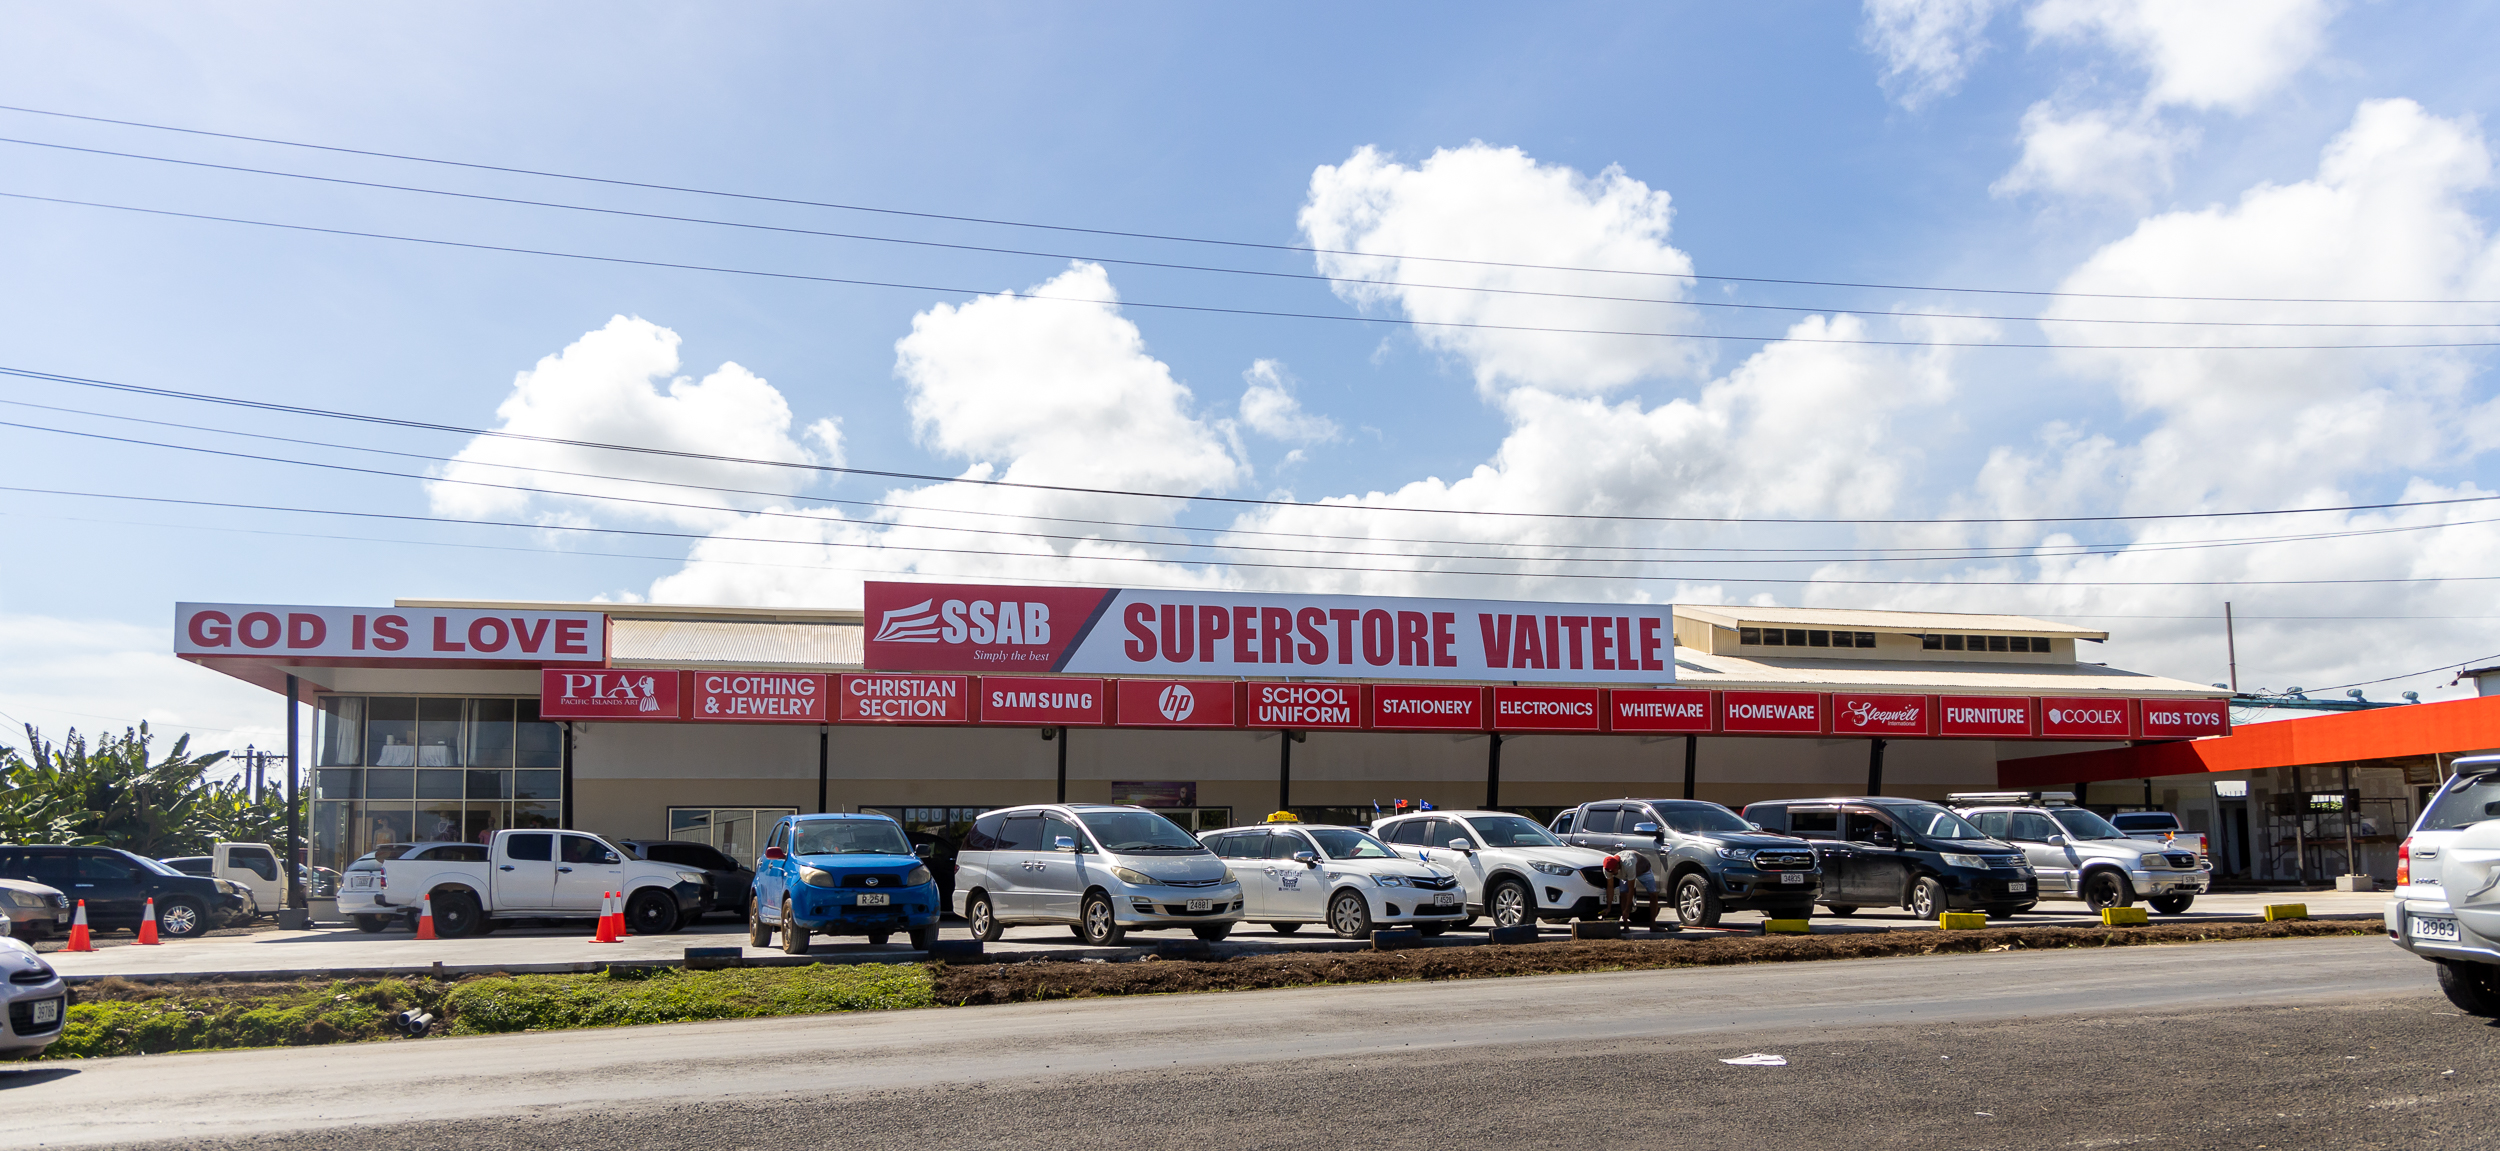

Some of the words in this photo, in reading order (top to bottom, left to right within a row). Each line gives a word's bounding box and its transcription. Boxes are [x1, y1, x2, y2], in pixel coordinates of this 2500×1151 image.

[942, 600, 1050, 644] SSAB
[189, 611, 326, 648] GOD
[352, 615, 409, 651] IS
[433, 617, 588, 654] LOVE
[1124, 603, 1457, 667] SUPERSTORE
[1478, 614, 1663, 670] VAITELE
[974, 650, 1008, 662] Simply
[1011, 650, 1026, 660] the
[1029, 651, 1050, 661] best
[561, 674, 639, 698] PIA
[706, 677, 815, 695] CLOTHING
[850, 679, 955, 697] CHRISTIAN
[993, 692, 1091, 709] SAMSUNG
[1161, 685, 1193, 721] hp
[1262, 687, 1347, 704] SCHOOL
[705, 697, 719, 713] &
[726, 697, 815, 715] JEWELRY
[860, 699, 945, 716] SECTION
[1259, 706, 1349, 722] UNIFORM
[1383, 700, 1472, 714] STATIONERY
[1501, 701, 1592, 715] ELECTRONICS
[1620, 704, 1703, 717] WHITEWARE
[1730, 704, 1814, 719] HOMEWARE
[1841, 701, 1919, 727] Sleepwell
[1948, 708, 2024, 723] FURNITURE
[2063, 709, 2121, 723] COOLEX
[2150, 712, 2180, 724] KIDS
[2184, 713, 2219, 725] TOYS
[907, 810, 989, 820] LOUNG
[2416, 921, 2454, 936] 10983
